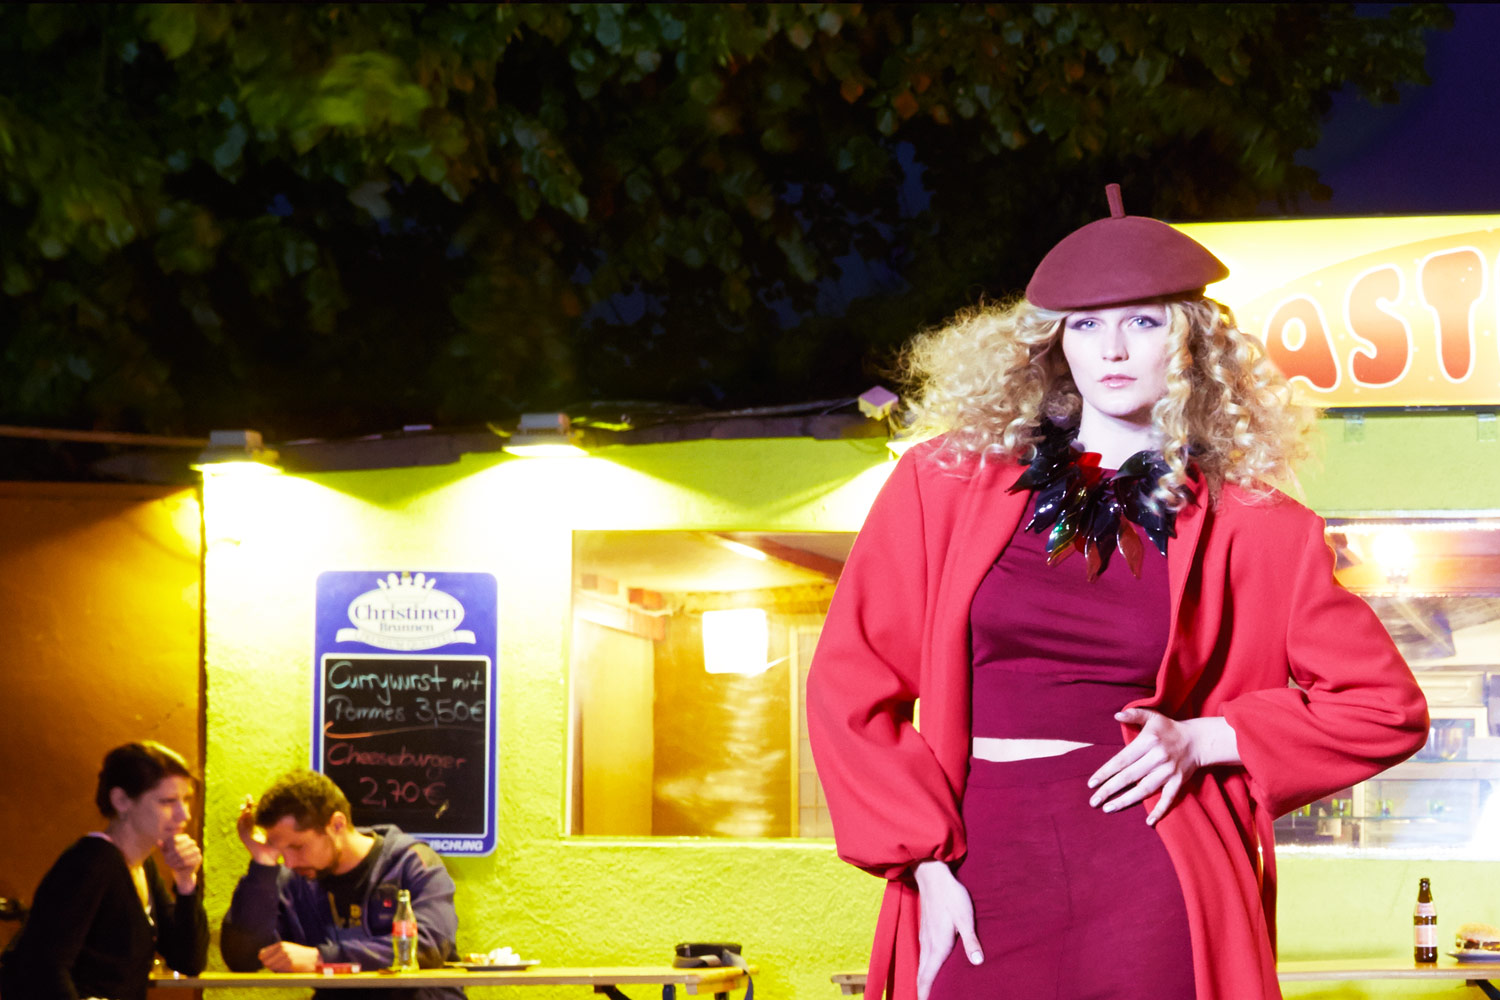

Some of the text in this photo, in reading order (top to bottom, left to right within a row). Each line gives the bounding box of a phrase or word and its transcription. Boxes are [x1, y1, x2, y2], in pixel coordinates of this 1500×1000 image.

[354, 604, 458, 621] Christinen
[379, 622, 435, 632] Brunnen
[328, 660, 484, 705] Currywurst mit
[327, 694, 486, 728] Pommes 3,50€
[327, 742, 467, 780] Cheeseburger
